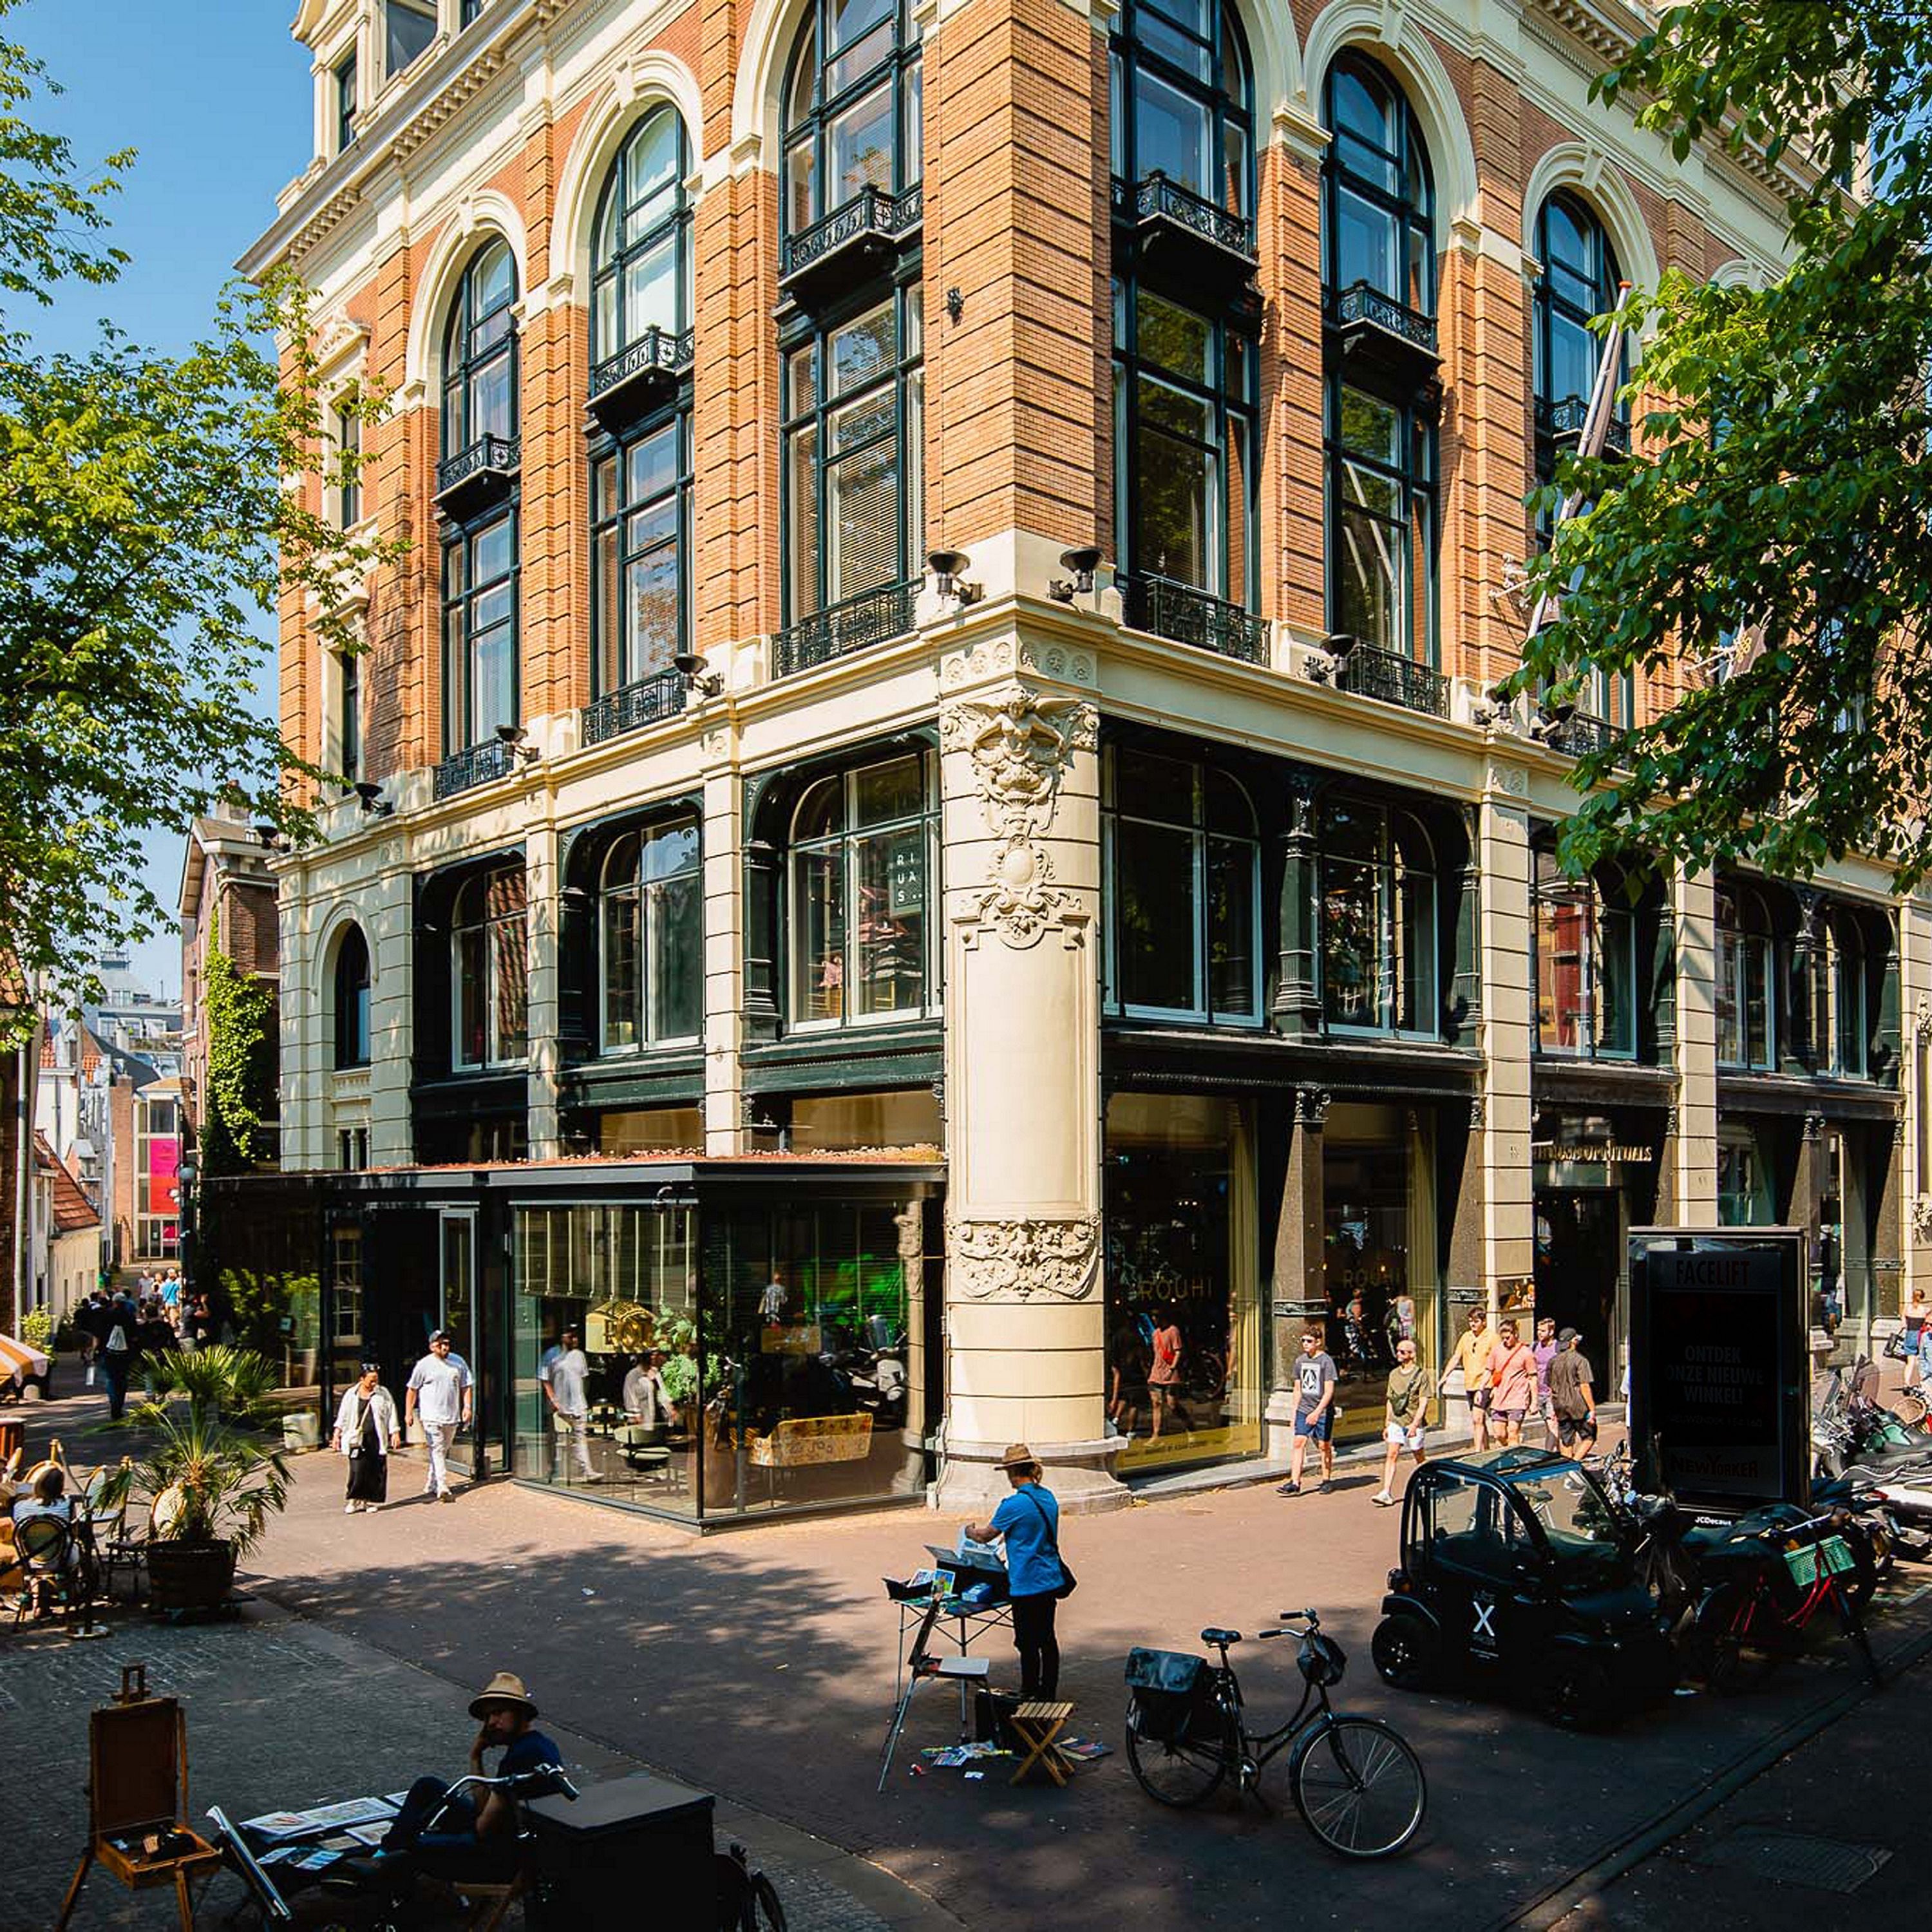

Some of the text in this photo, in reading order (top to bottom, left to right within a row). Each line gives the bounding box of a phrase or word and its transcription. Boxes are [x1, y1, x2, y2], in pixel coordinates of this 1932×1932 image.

[1602, 1146, 1652, 1162] RITUALS
[1676, 1260, 1750, 1287] FACELIFT
[1685, 1345, 1741, 1363] ONTDEK
[1665, 1365, 1765, 1385] ONZE NIEUWE
[1683, 1387, 1744, 1405] WINKEL!
